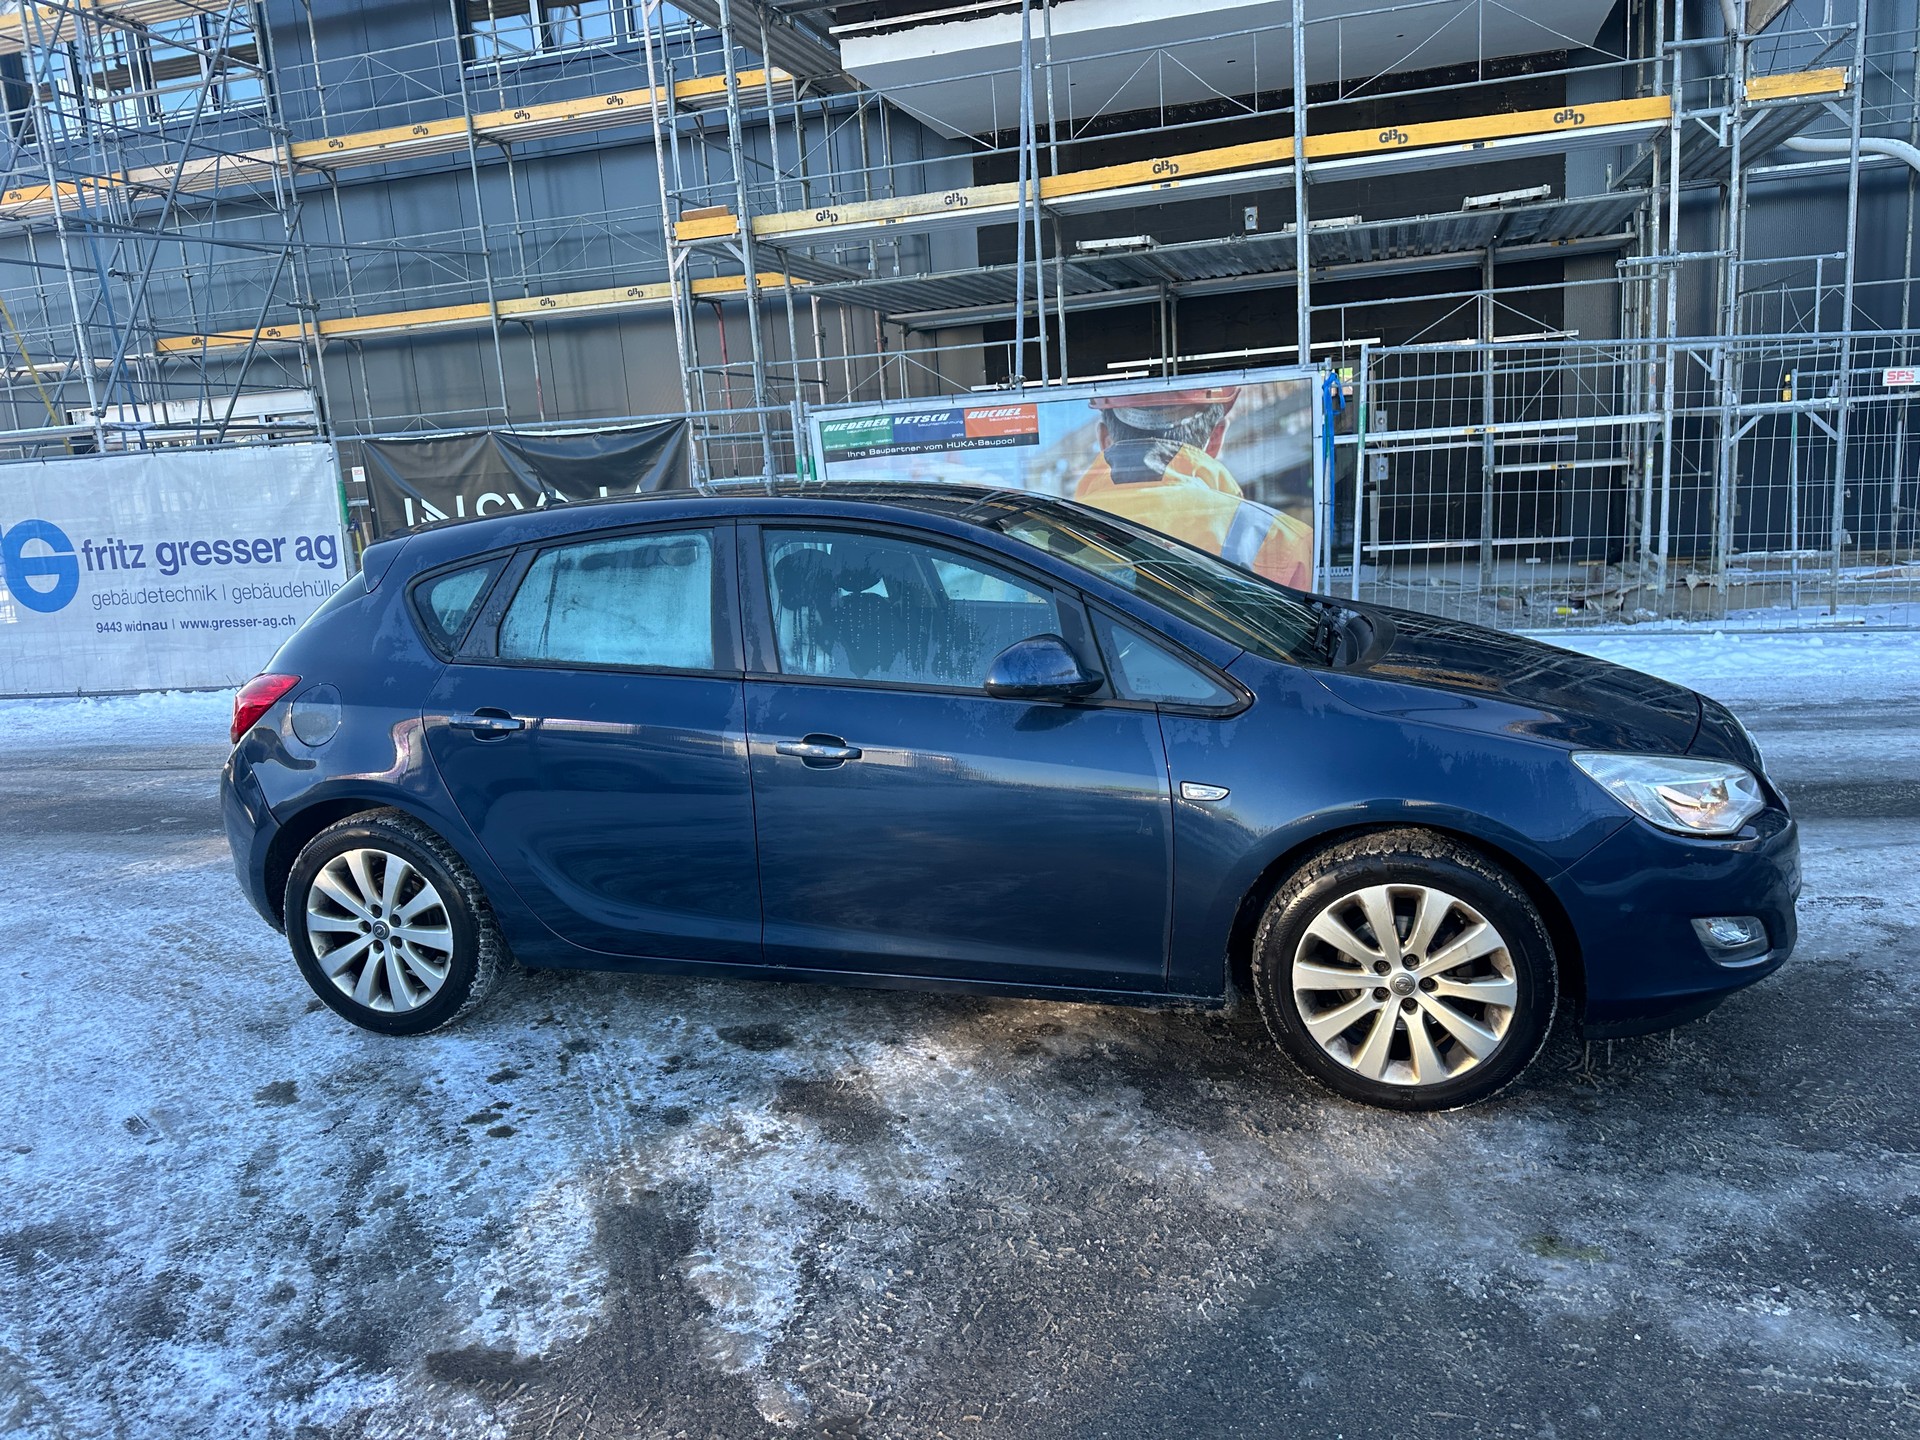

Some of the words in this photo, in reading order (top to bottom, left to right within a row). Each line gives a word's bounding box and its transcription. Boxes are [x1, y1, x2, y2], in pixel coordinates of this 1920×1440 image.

[606, 95, 623, 106] GBD
[514, 111, 530, 121] GBD
[1553, 109, 1584, 125] GBD
[412, 125, 428, 136] GBD
[1378, 129, 1408, 145] GBD
[328, 139, 343, 149] GBD
[1152, 160, 1178, 175] GBD
[944, 193, 967, 207] GBD
[815, 209, 838, 223] GBD
[627, 288, 643, 298] GBD
[540, 298, 555, 307] GBD
[1886, 370, 1915, 381] SFS
[823, 417, 891, 433] NIEDERER
[893, 412, 951, 425] VETSCH
[847, 450, 867, 459] Ihre
[868, 443, 922, 457] Baupartner
[946, 437, 1016, 449] HUKA-Baupool
[81, 538, 147, 572] fritz
[155, 535, 287, 577] gresser
[294, 533, 339, 570] ag
[91, 584, 217, 611] gebäudetechnik
[231, 579, 340, 605] gebäudehülle
[96, 621, 123, 634] 9443
[124, 619, 169, 633] widnau
[179, 614, 297, 632] www.gresser-ag.ch
